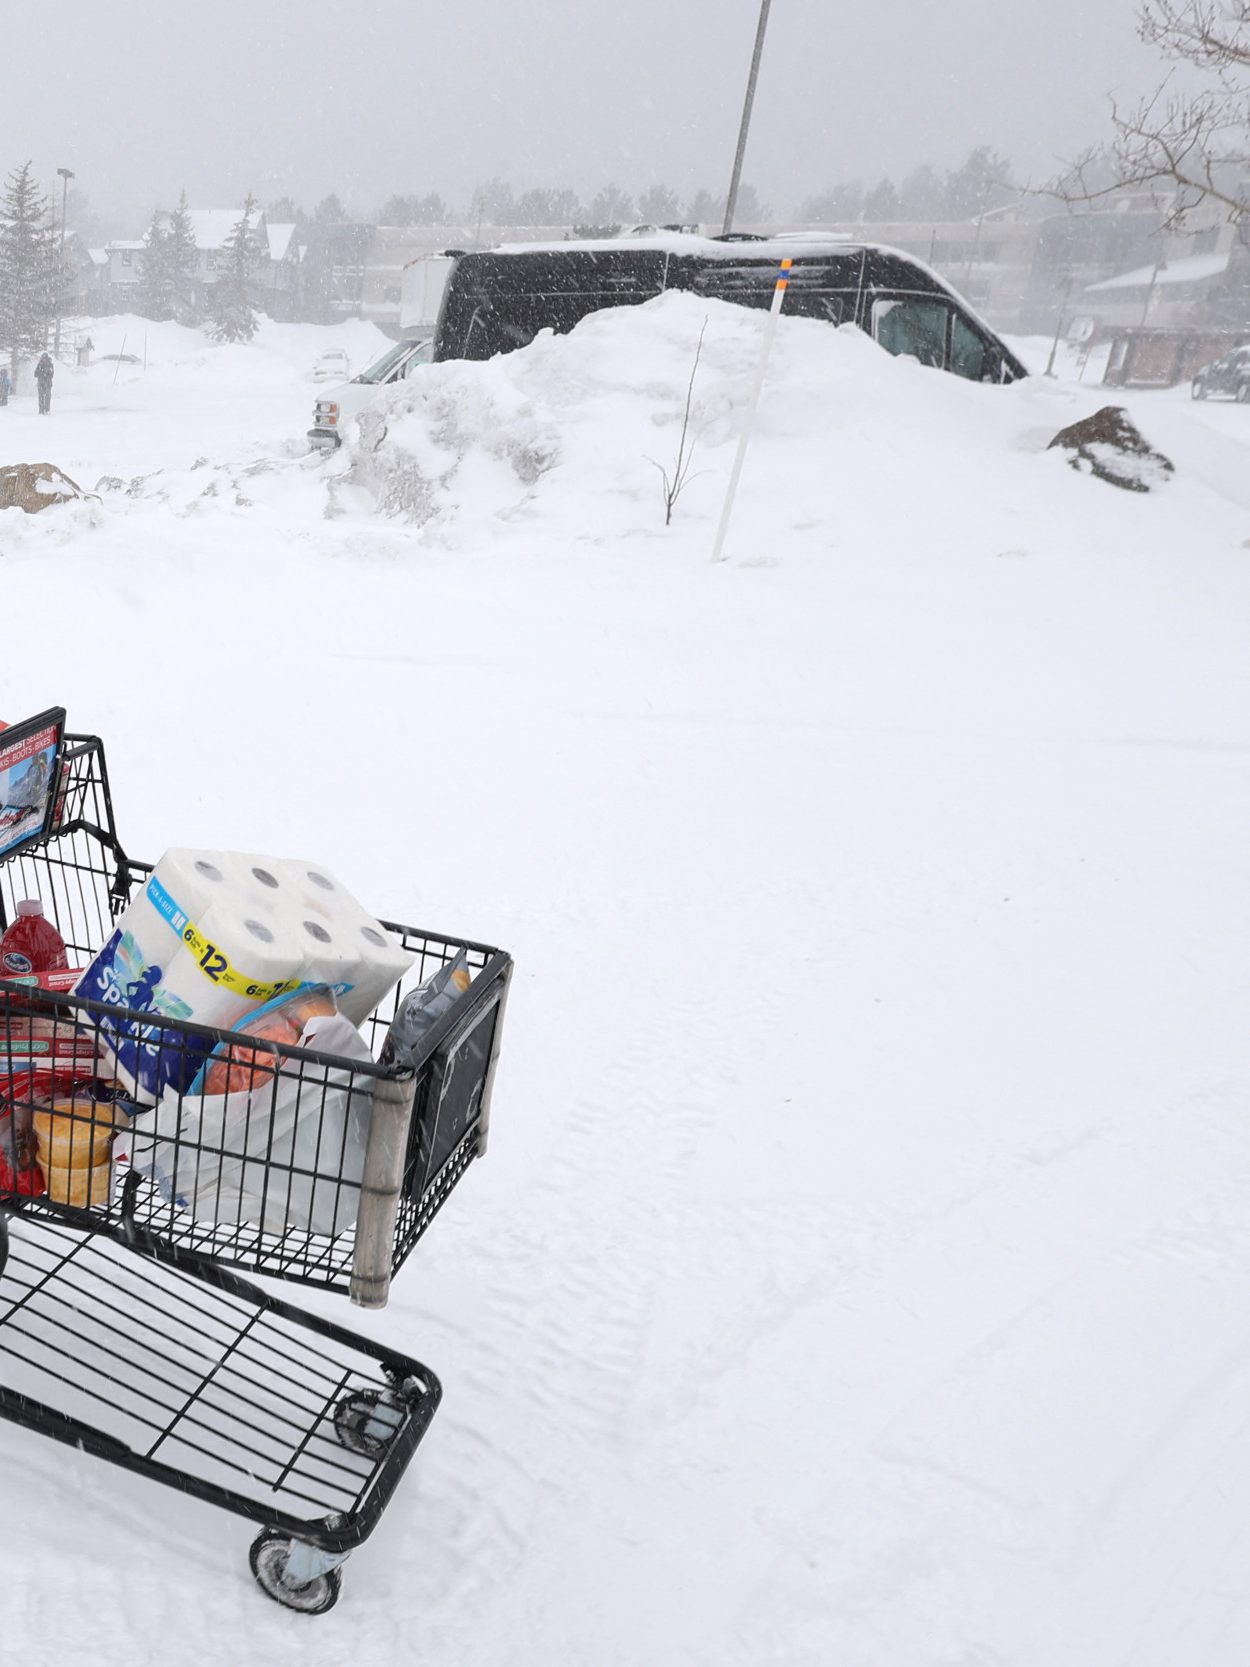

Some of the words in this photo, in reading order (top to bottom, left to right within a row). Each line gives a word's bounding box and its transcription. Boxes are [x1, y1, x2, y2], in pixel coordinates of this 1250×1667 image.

[12, 745, 33, 762] BOOTS
[34, 735, 51, 751] BIKES
[149, 883, 174, 915] PICK-A-SIZE
[184, 928, 195, 941] 6
[199, 943, 228, 982] 12
[246, 984, 259, 996] 6
[97, 966, 160, 1056] Spakle
